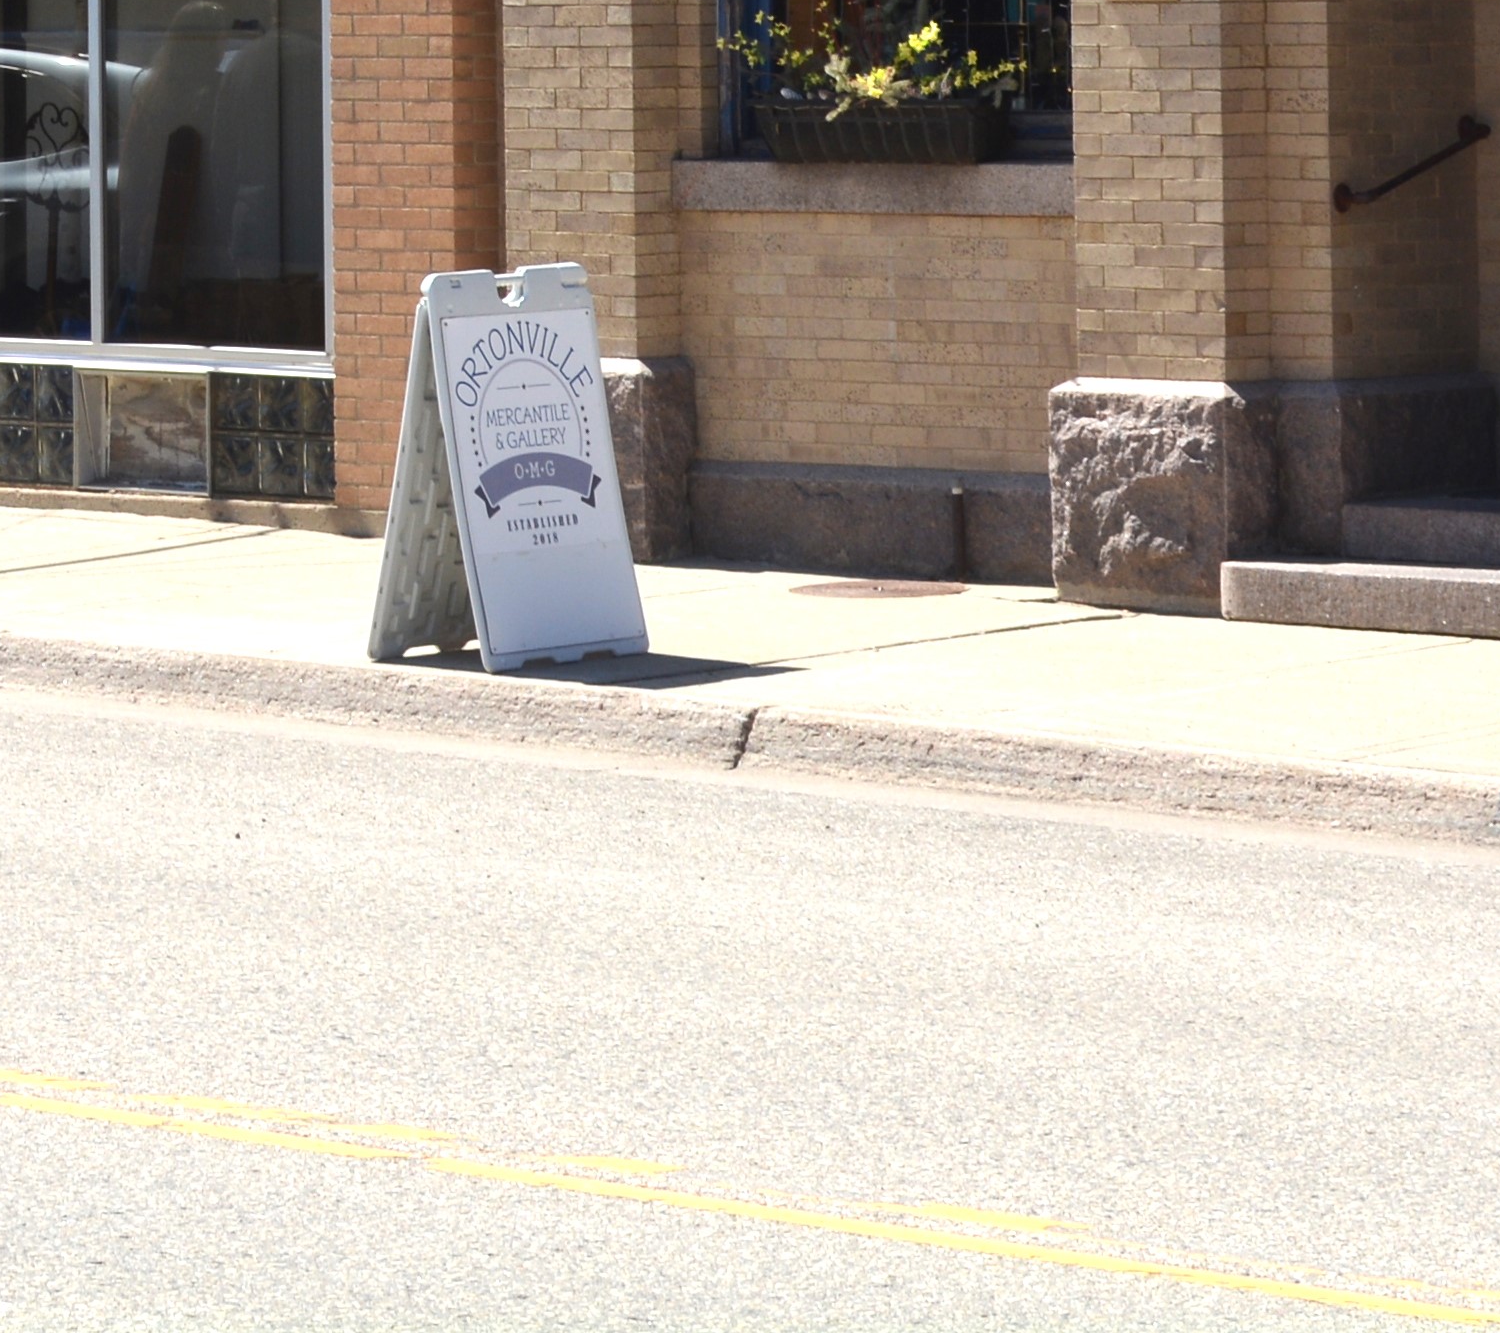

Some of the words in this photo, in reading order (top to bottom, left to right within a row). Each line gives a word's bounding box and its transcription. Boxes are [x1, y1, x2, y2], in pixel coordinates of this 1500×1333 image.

[455, 320, 593, 407] ORTONVILLE
[486, 403, 571, 428] MERCANTILE
[495, 433, 505, 449] &
[507, 427, 566, 449] GALLERY
[507, 516, 579, 532] ESTABLISHED
[533, 532, 559, 546] 2018
